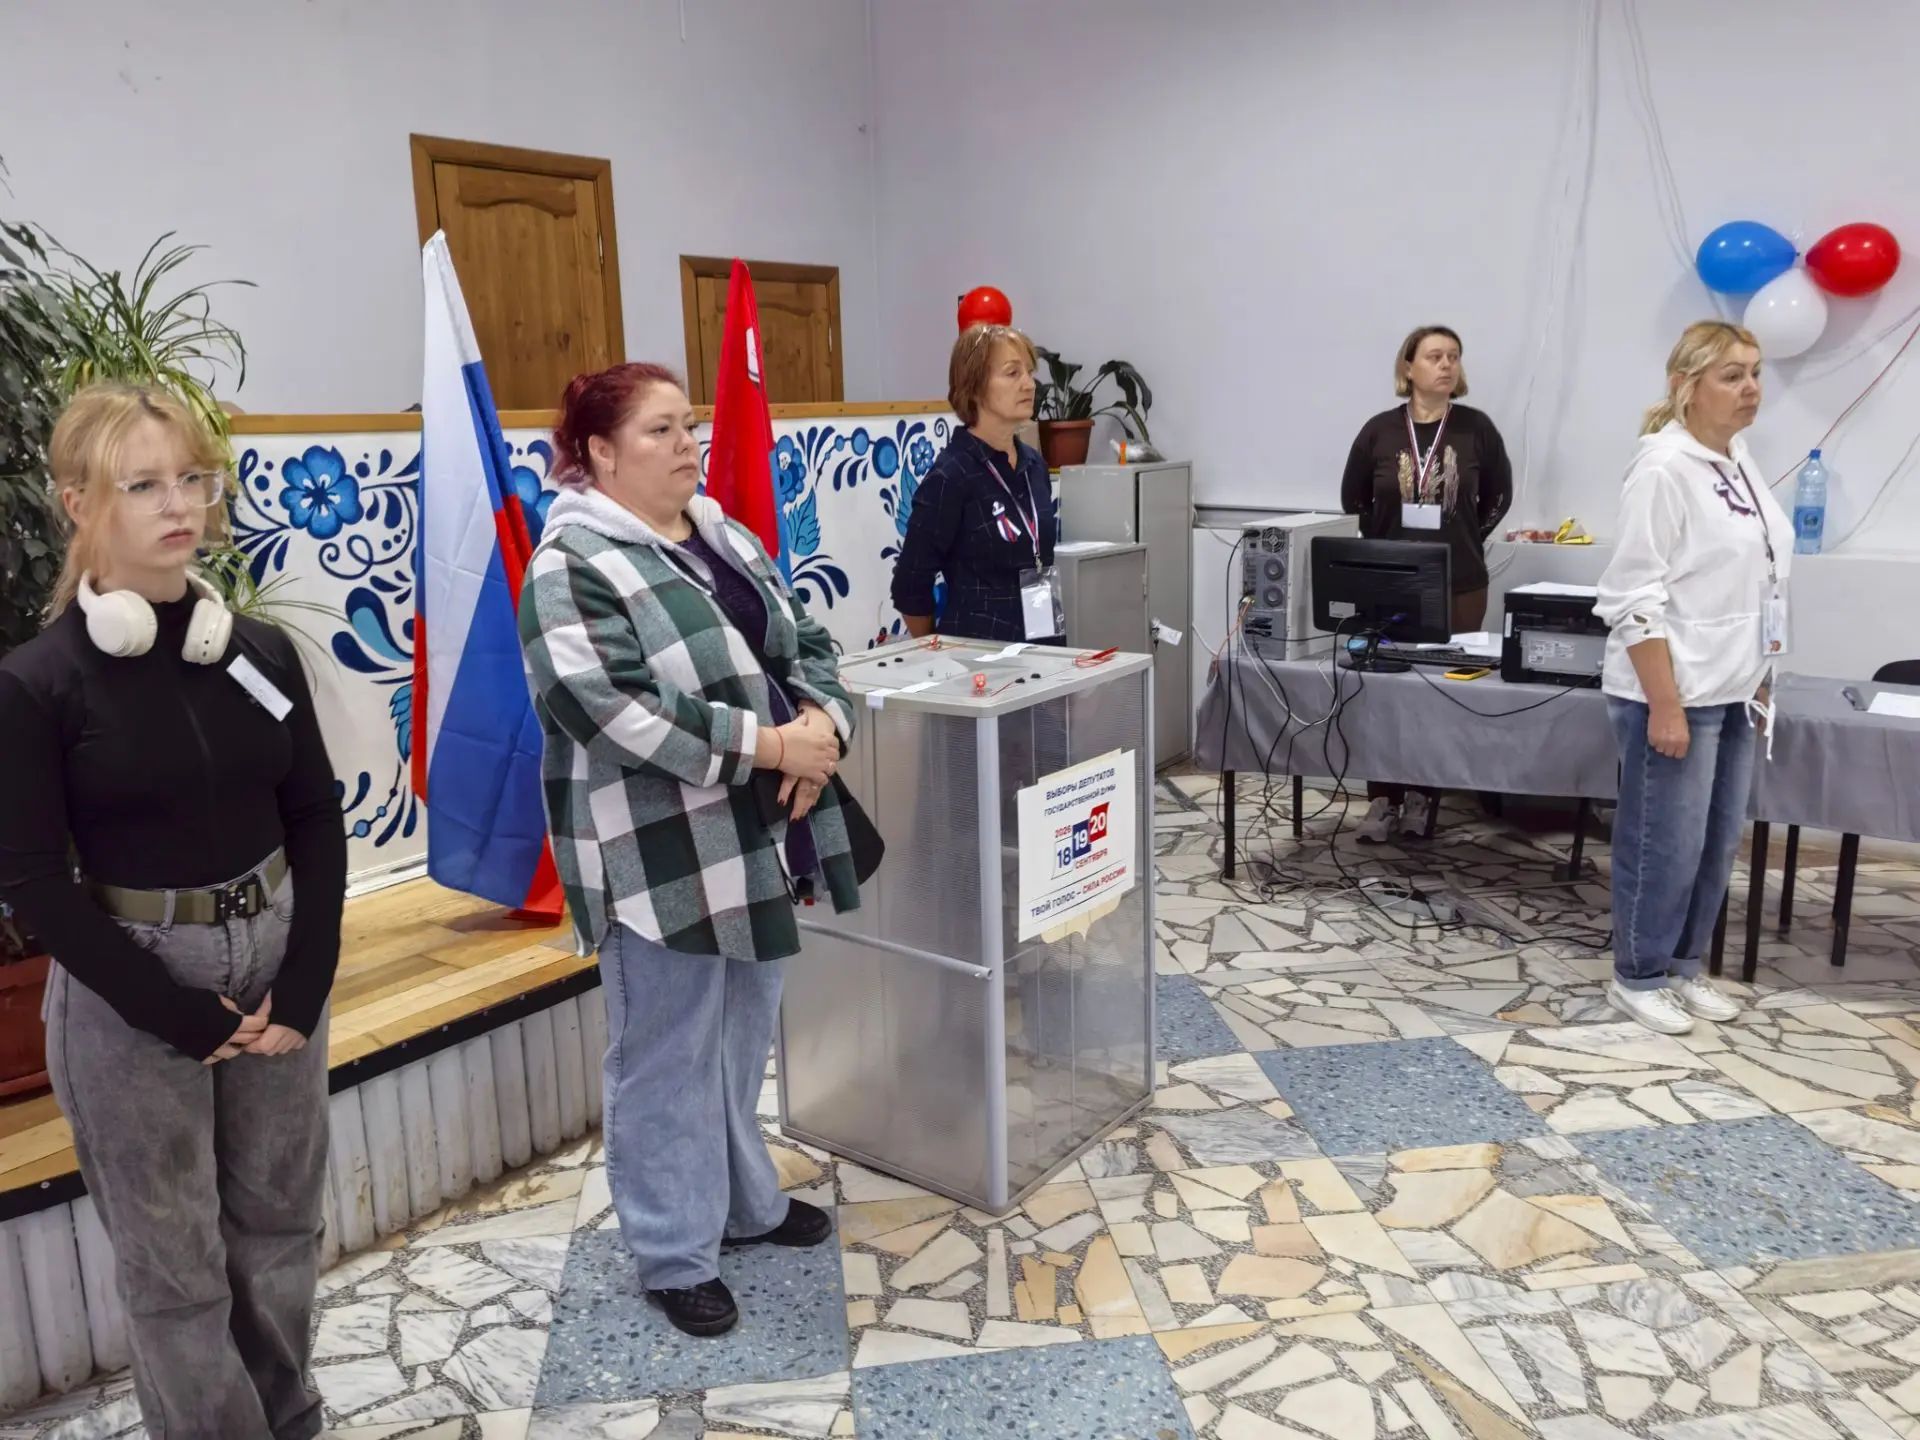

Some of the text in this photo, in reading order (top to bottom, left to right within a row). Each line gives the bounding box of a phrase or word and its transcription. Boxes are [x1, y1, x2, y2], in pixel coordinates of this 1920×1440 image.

[1046, 768, 1115, 800] ВЫБОРЫ ДЕПУТАТОВ
[1044, 784, 1116, 817] ГОСУДАРСТВЕННОЙ ДУМЫ
[1055, 825, 1072, 838] 2026
[1057, 812, 1106, 868] 18 19 20
[1075, 848, 1108, 869] СЕНТЯБРЯ
[1031, 901, 1051, 917] ТВОЙ
[1052, 891, 1075, 908] ГОЛОС
[1082, 880, 1100, 894] СИЛА
